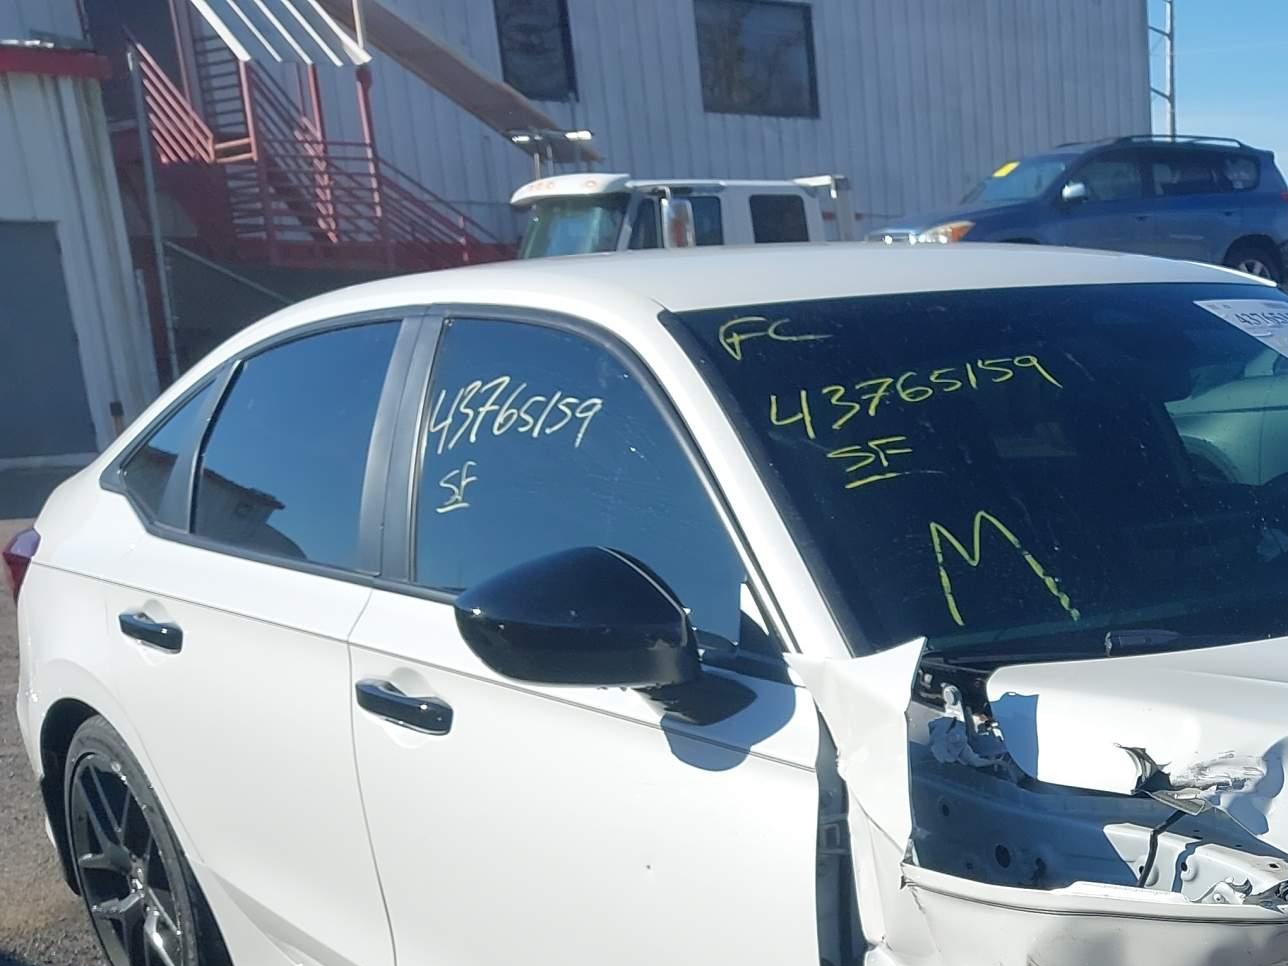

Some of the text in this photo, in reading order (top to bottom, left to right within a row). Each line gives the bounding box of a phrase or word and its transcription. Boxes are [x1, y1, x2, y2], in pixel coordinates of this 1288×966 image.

[719, 317, 833, 360] FC
[429, 375, 603, 454] 43765159
[769, 355, 1064, 439] 43765159
[439, 460, 478, 505] SF
[826, 436, 913, 474] SF
[930, 511, 1079, 626] M
